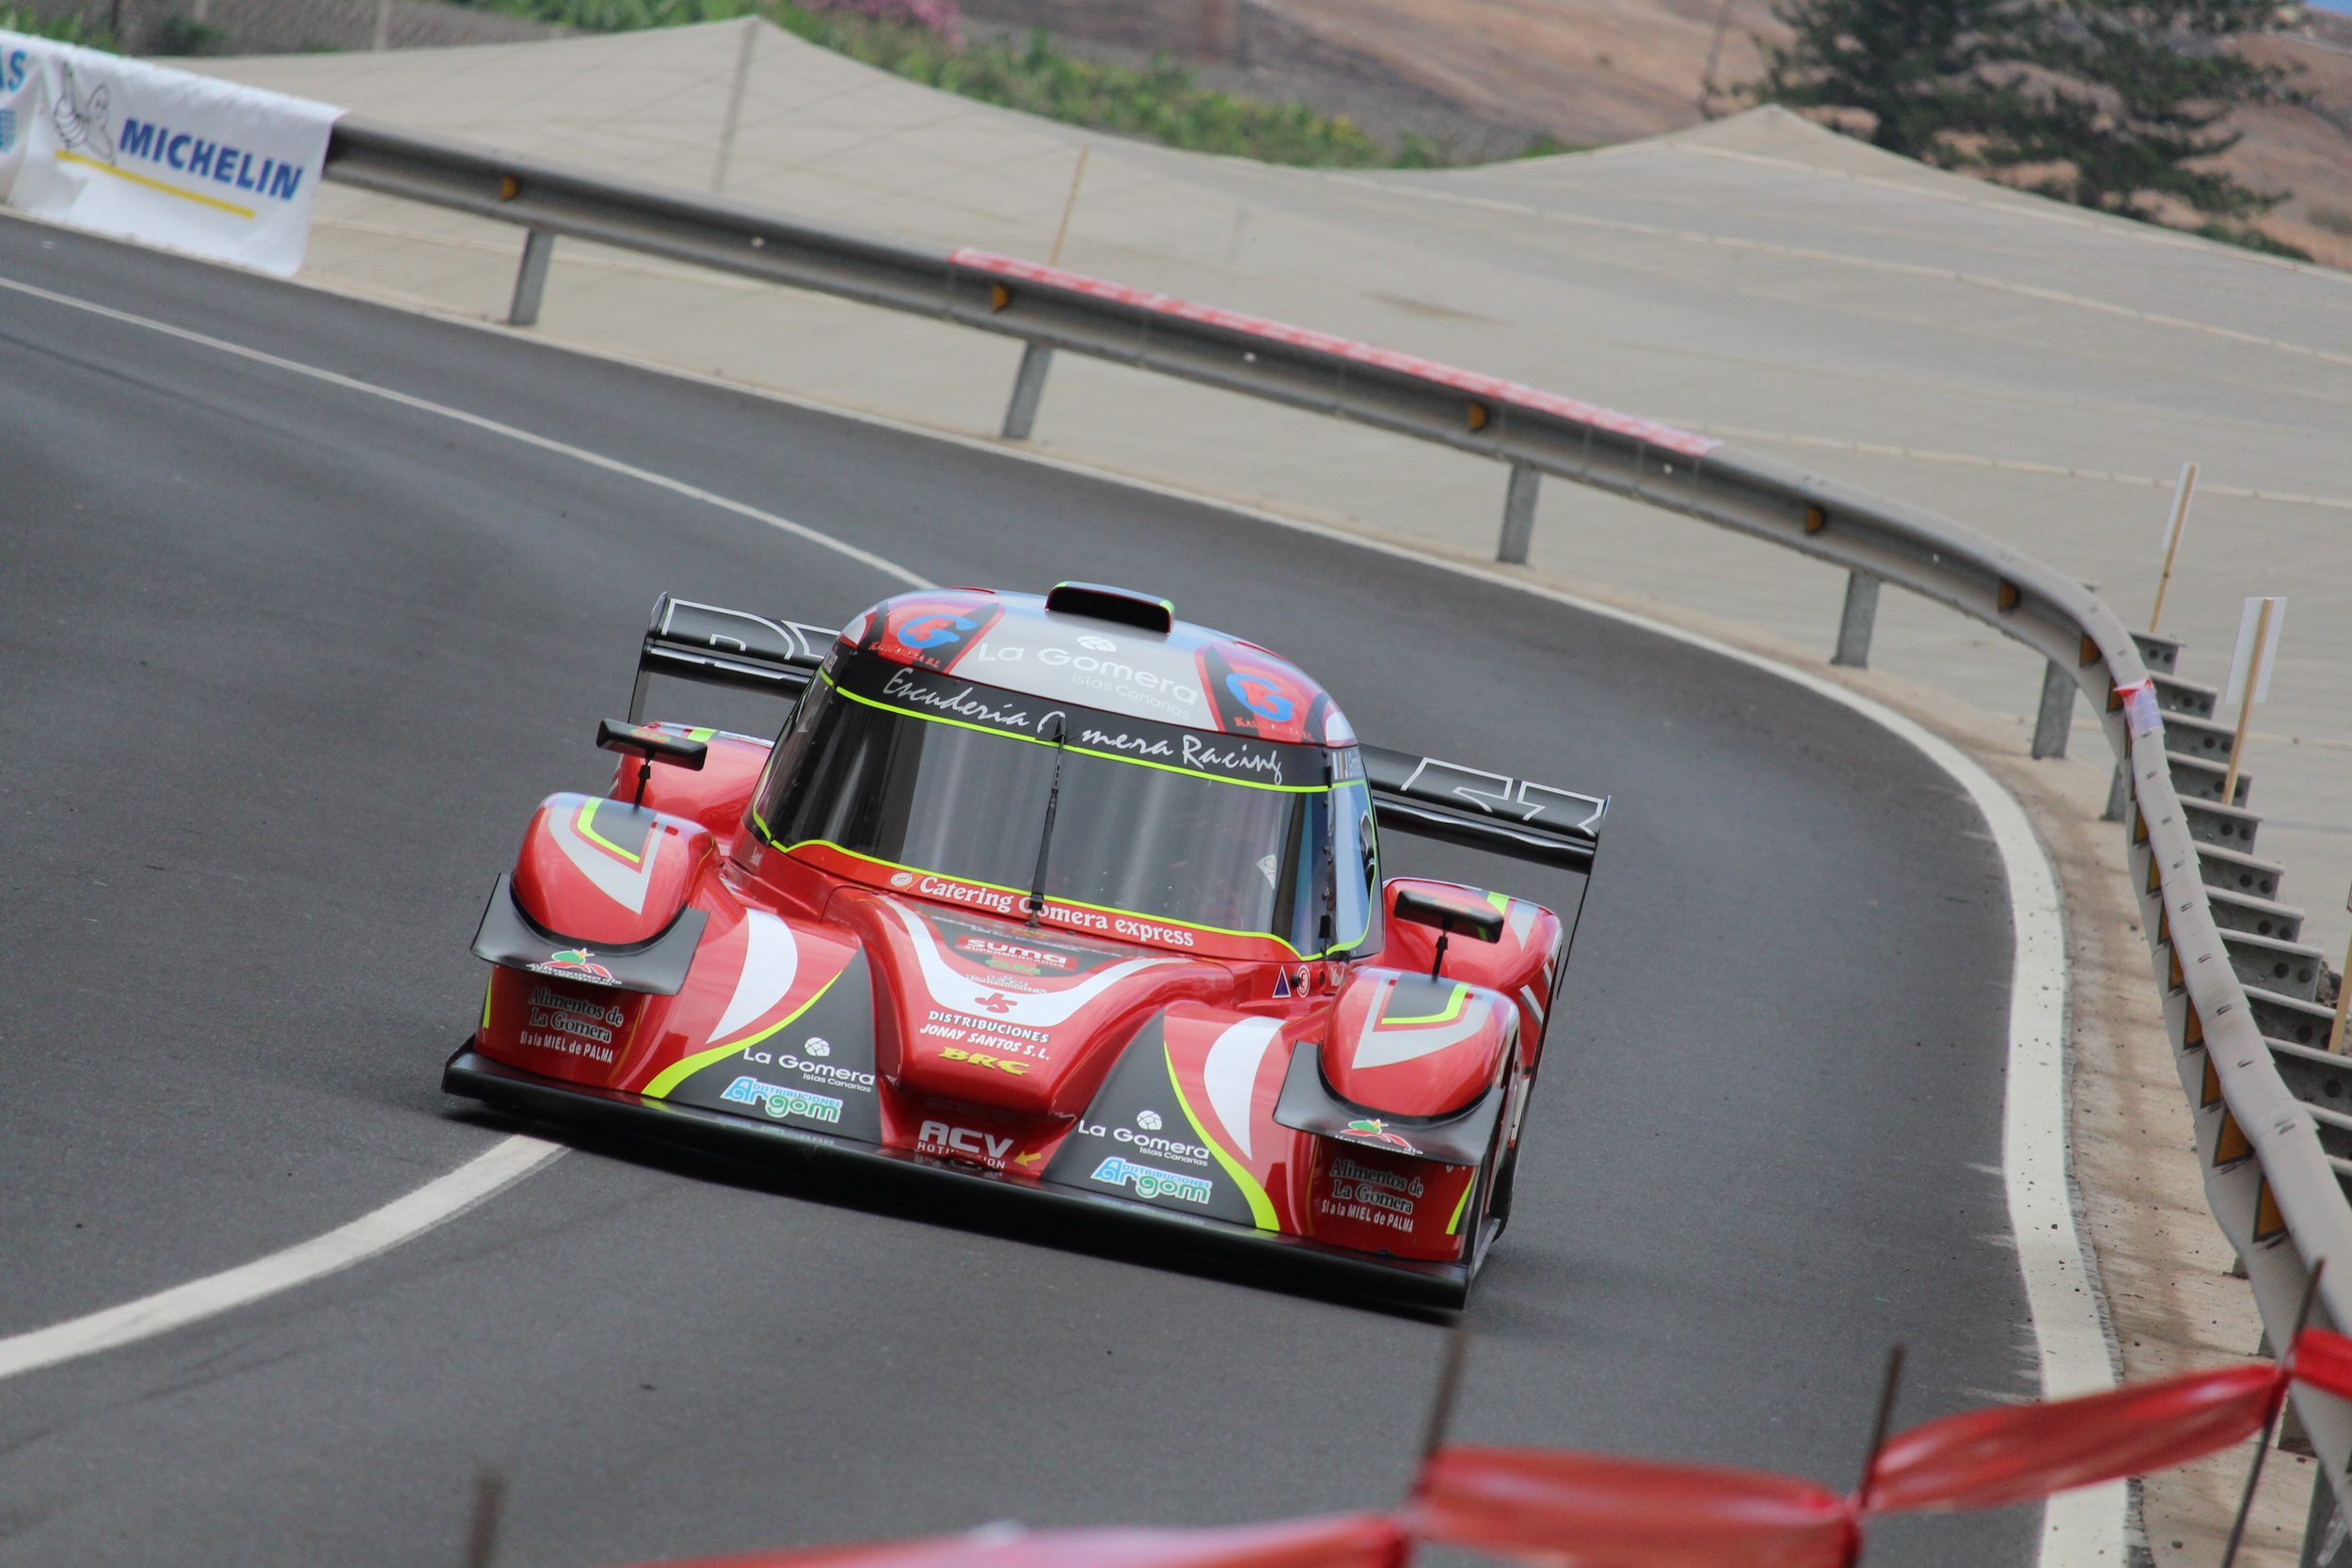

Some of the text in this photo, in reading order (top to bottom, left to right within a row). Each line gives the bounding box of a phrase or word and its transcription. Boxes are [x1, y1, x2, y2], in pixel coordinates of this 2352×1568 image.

[119, 119, 304, 200] MICHELIN
[977, 642, 1199, 705] La Gomera
[1072, 673, 1191, 721] Islas Canarias
[882, 667, 1030, 726] Escudería
[1182, 734, 1282, 785] Racing
[919, 877, 1014, 912] Catering
[1115, 916, 1195, 947] express
[964, 945, 1065, 968] SUPERMERCADOS
[966, 940, 1067, 965] suma
[529, 987, 624, 1027] Alimentos de
[530, 1006, 612, 1044] La Gomera
[920, 1023, 966, 1041] JONAY
[966, 1032, 1023, 1053] SANTOS
[928, 1010, 1050, 1044] DISTRIBUCIONES
[543, 1034, 566, 1053] MIEL
[568, 1039, 582, 1055] de
[582, 1042, 613, 1065] PALMA
[743, 1046, 876, 1086] La Gomera
[938, 1046, 1031, 1076] BRC
[720, 1075, 844, 1124] Argom
[753, 1082, 843, 1108] DISTRIBUCIONES
[803, 1073, 872, 1093] Islas Canarias
[918, 1119, 1015, 1159] ACV
[1078, 1119, 1211, 1160] La Gomera
[1139, 1147, 1209, 1167] Islas Canarias
[1089, 1156, 1213, 1204] Argom
[1121, 1164, 1212, 1189] DISTRIBUCIONES
[1328, 1158, 1424, 1197] Alimentos de
[1331, 1180, 1414, 1215] La Gomera
[1347, 1204, 1371, 1222] MIEL
[1373, 1210, 1386, 1226] de
[1387, 1213, 1414, 1234] PALMA
